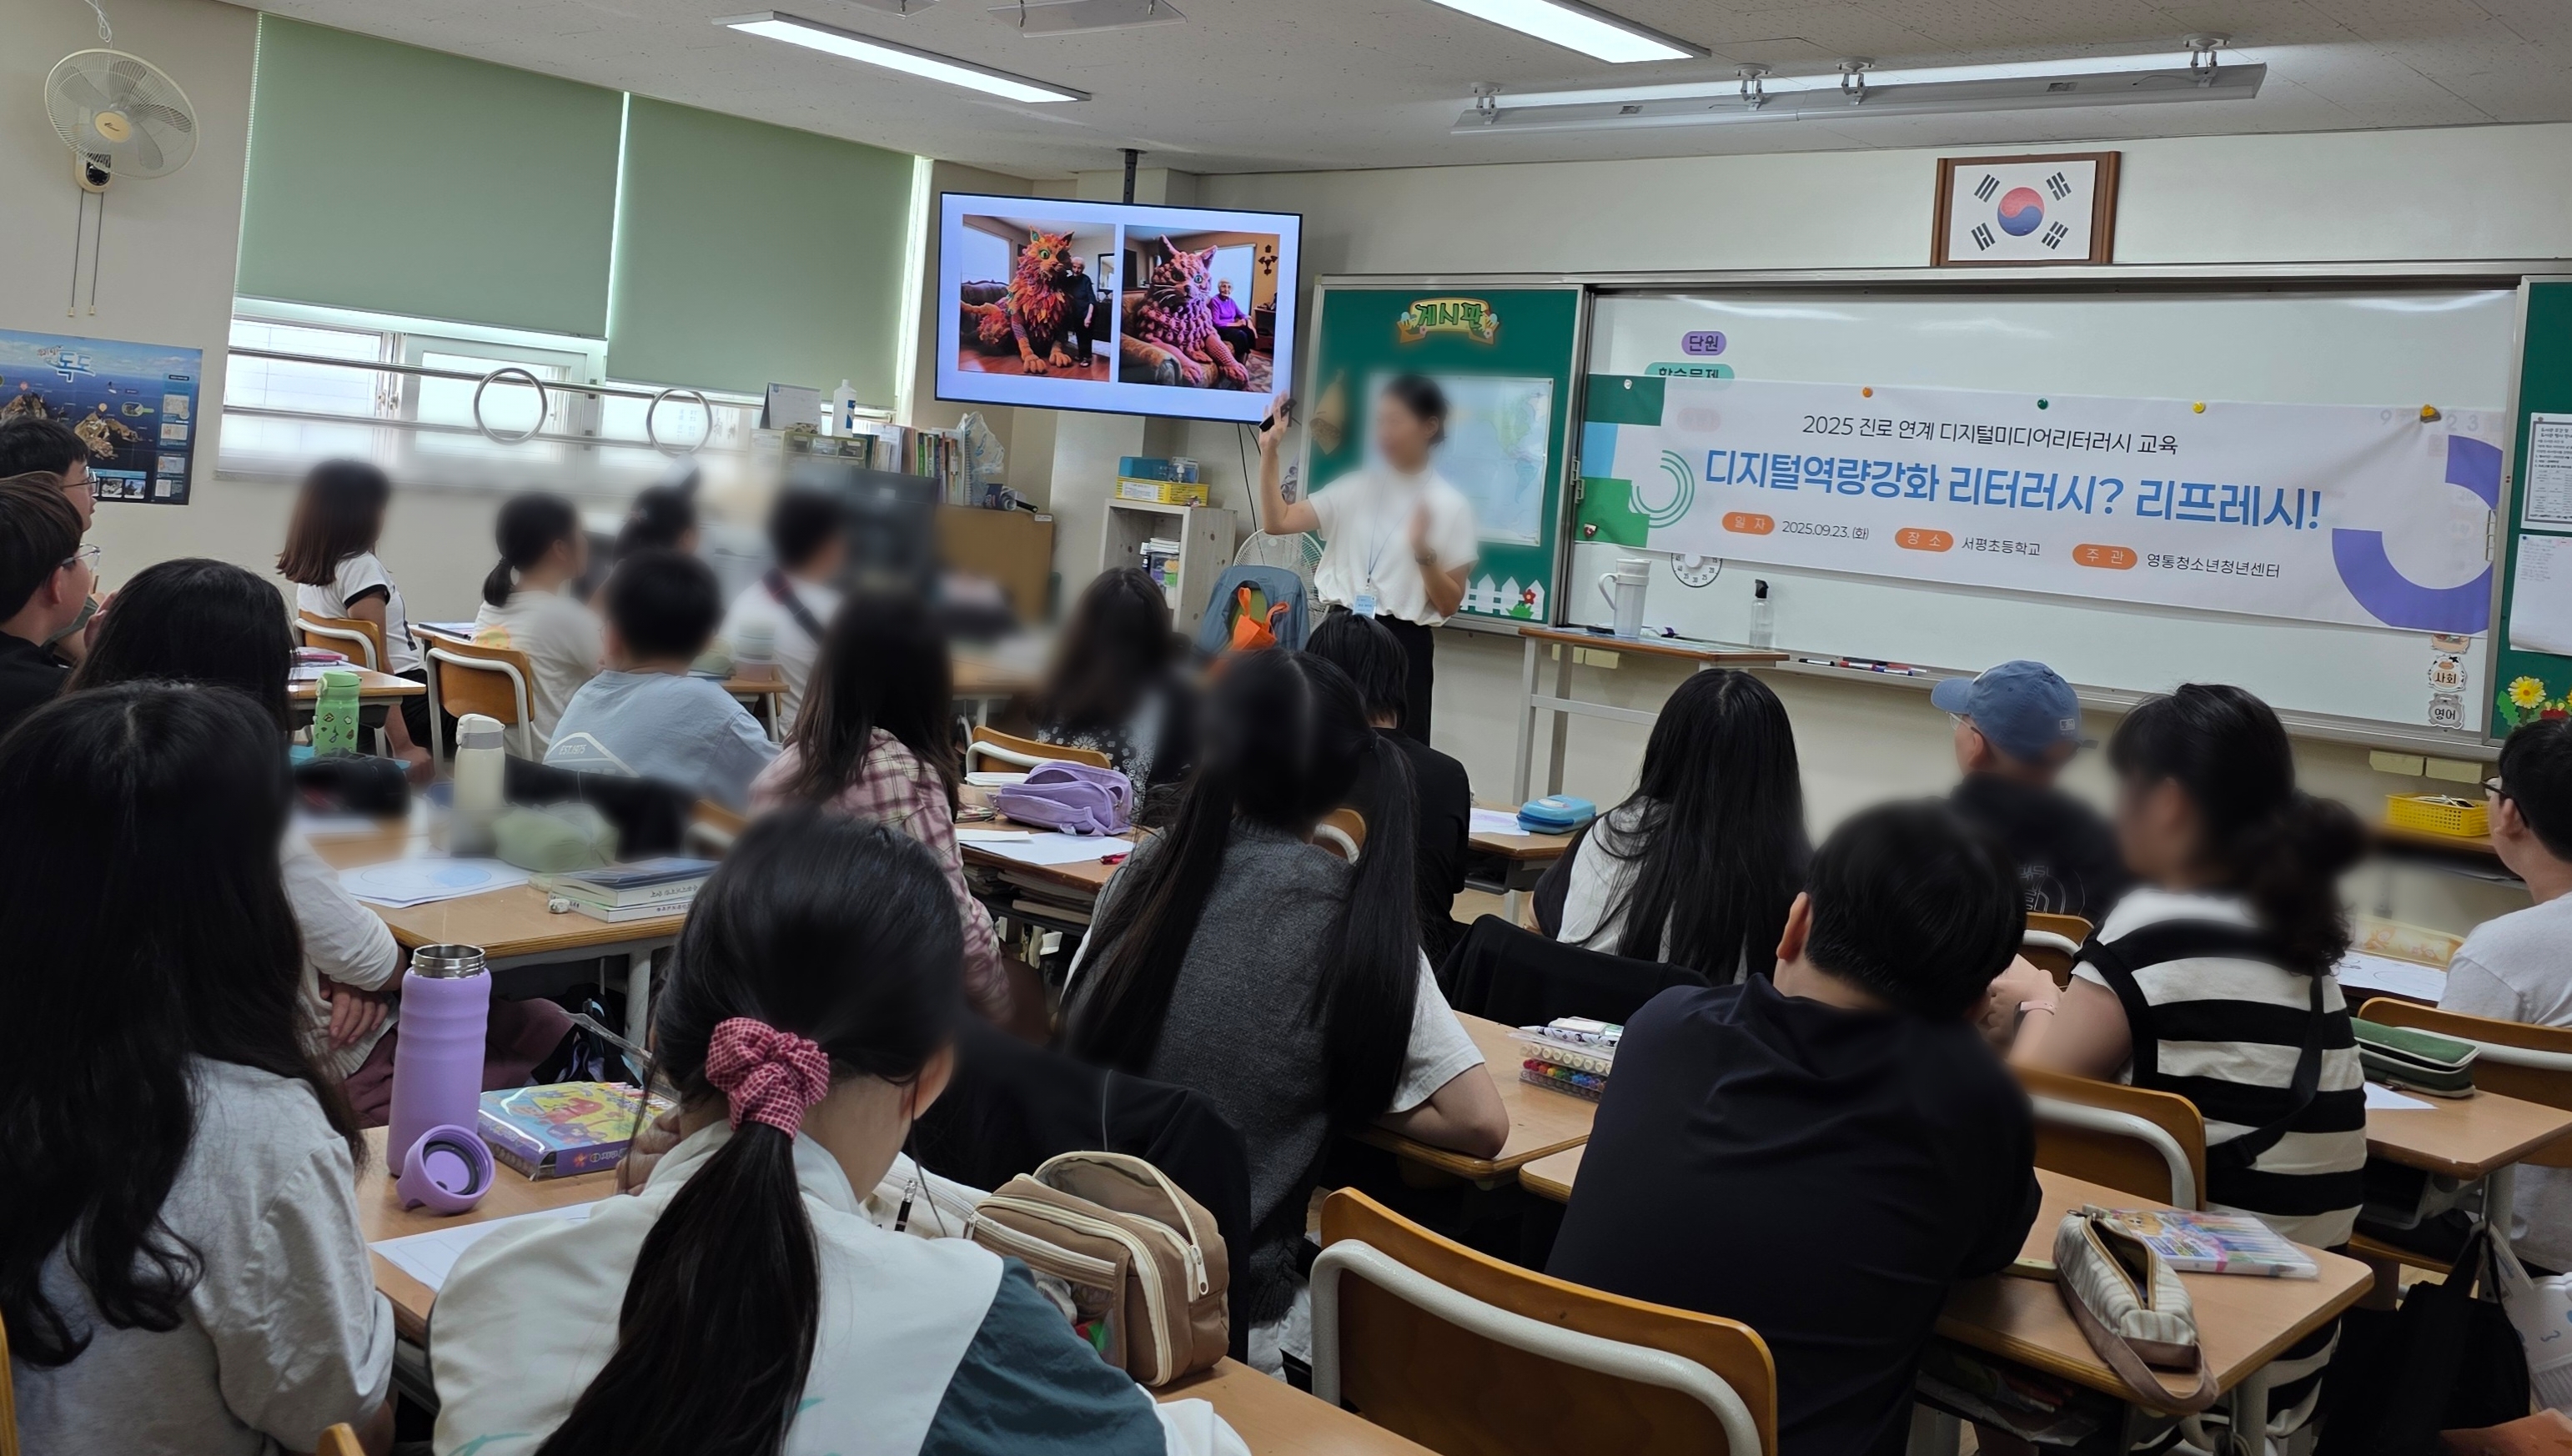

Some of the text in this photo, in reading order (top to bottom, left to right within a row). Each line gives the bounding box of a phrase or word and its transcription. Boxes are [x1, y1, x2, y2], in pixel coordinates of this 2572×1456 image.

[1415, 302, 1482, 329] 게시판
[1689, 335, 1719, 352] 단원
[45, 350, 96, 383] 독도
[1802, 415, 2178, 455] 2025 진로 연계 디지털미디어리터러시 교육
[1705, 449, 2321, 530] 디지털역량강화 리터러시? 리프레시!
[1781, 520, 1850, 539] 2025.09.23.
[1852, 526, 1870, 540] (화)
[1962, 537, 2041, 556] 서평초등학교
[2147, 553, 2280, 579] 영통청소년청년센터
[2435, 672, 2456, 684] 사회
[2435, 708, 2456, 720] 영어
